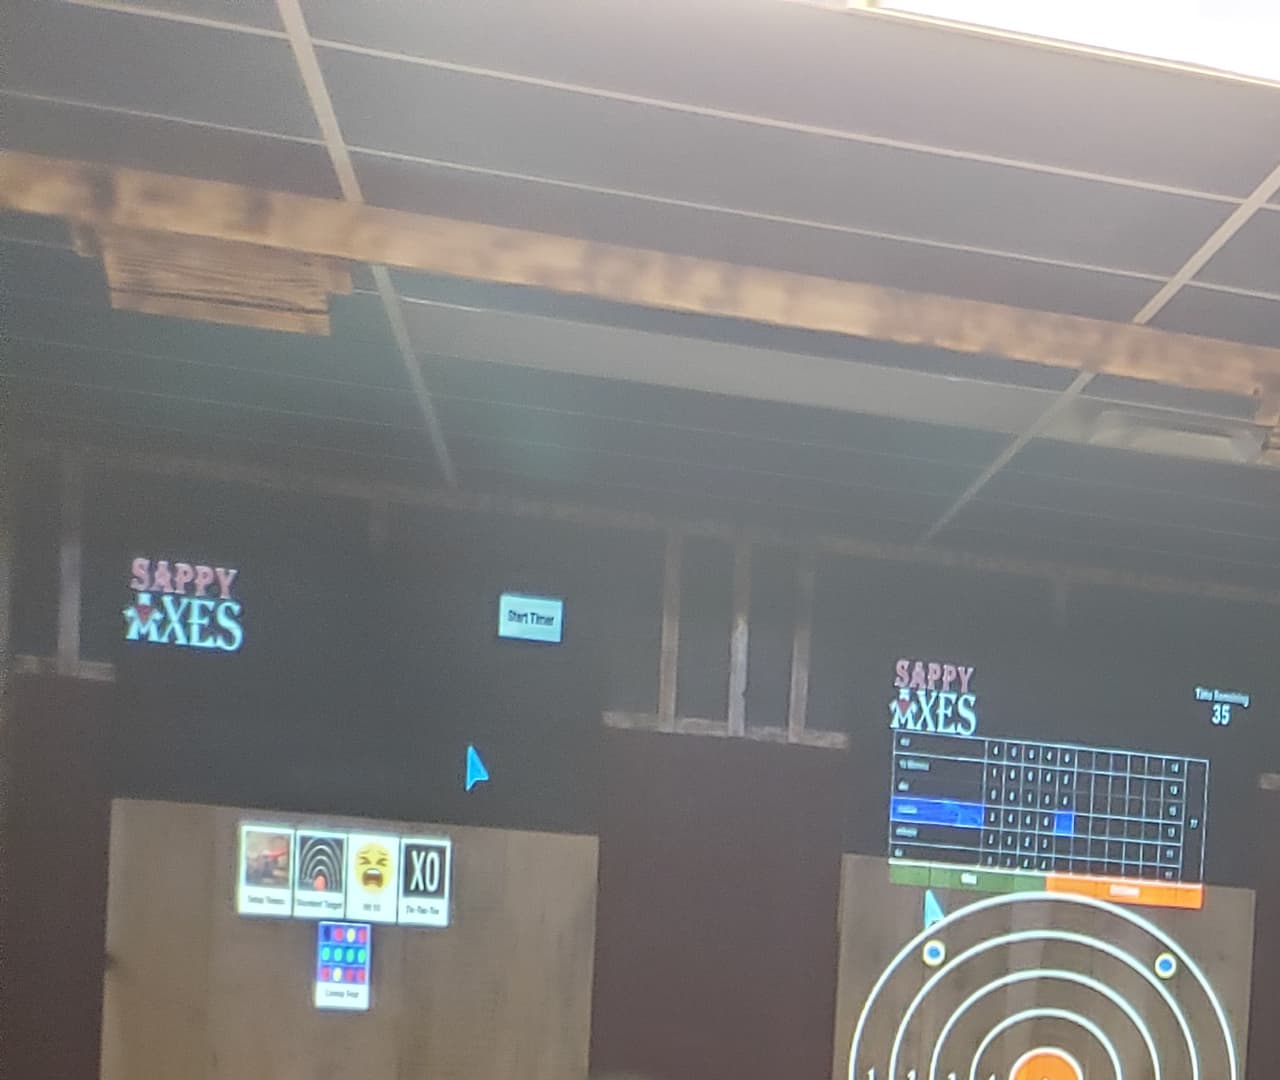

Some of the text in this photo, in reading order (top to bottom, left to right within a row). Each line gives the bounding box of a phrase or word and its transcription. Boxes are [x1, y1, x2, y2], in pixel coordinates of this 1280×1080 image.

[130, 557, 238, 600] SAPPY
[894, 659, 974, 694] SAPPY
[1211, 702, 1231, 726] 35
[409, 850, 441, 893] XO
